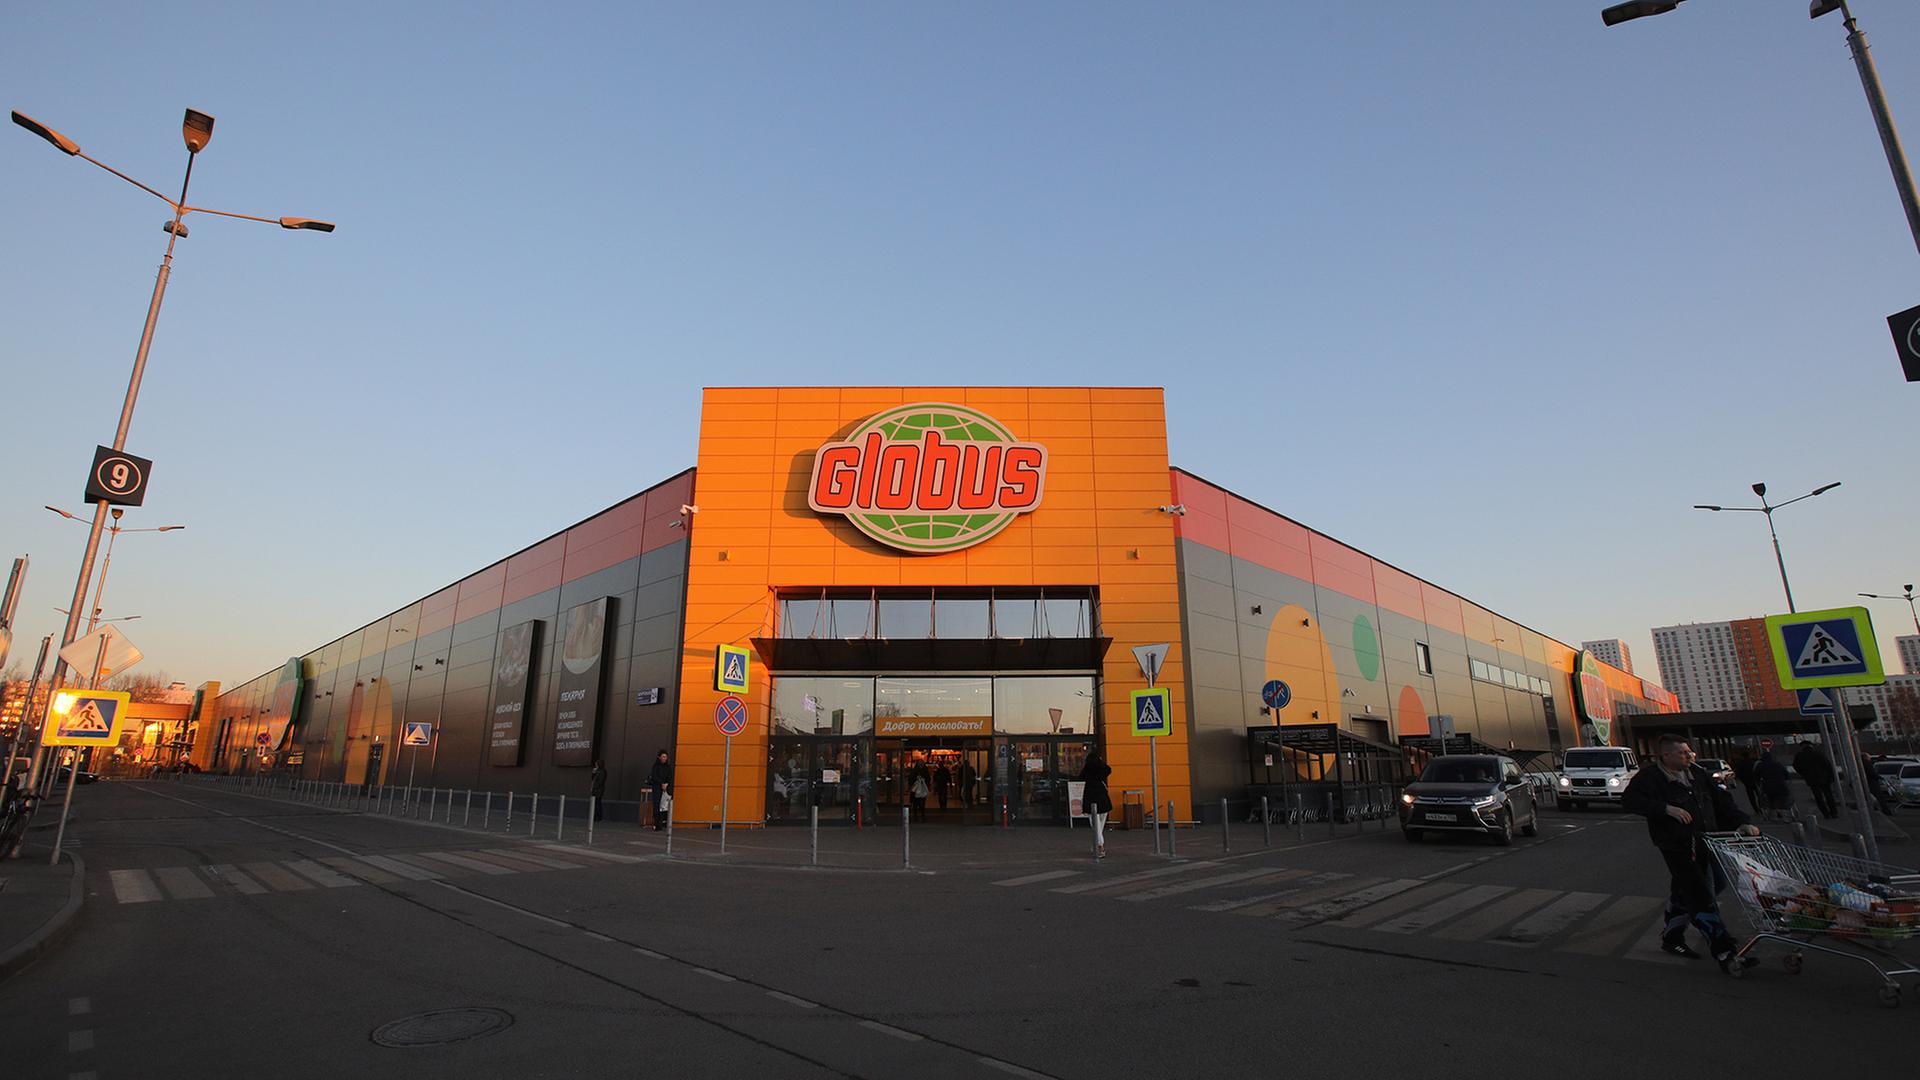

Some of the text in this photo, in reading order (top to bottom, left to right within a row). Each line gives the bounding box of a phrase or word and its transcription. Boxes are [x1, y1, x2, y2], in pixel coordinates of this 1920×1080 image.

[110, 463, 129, 489] 9
[814, 430, 1043, 511] Globus
[882, 720, 984, 732] Добро пожаловать!
